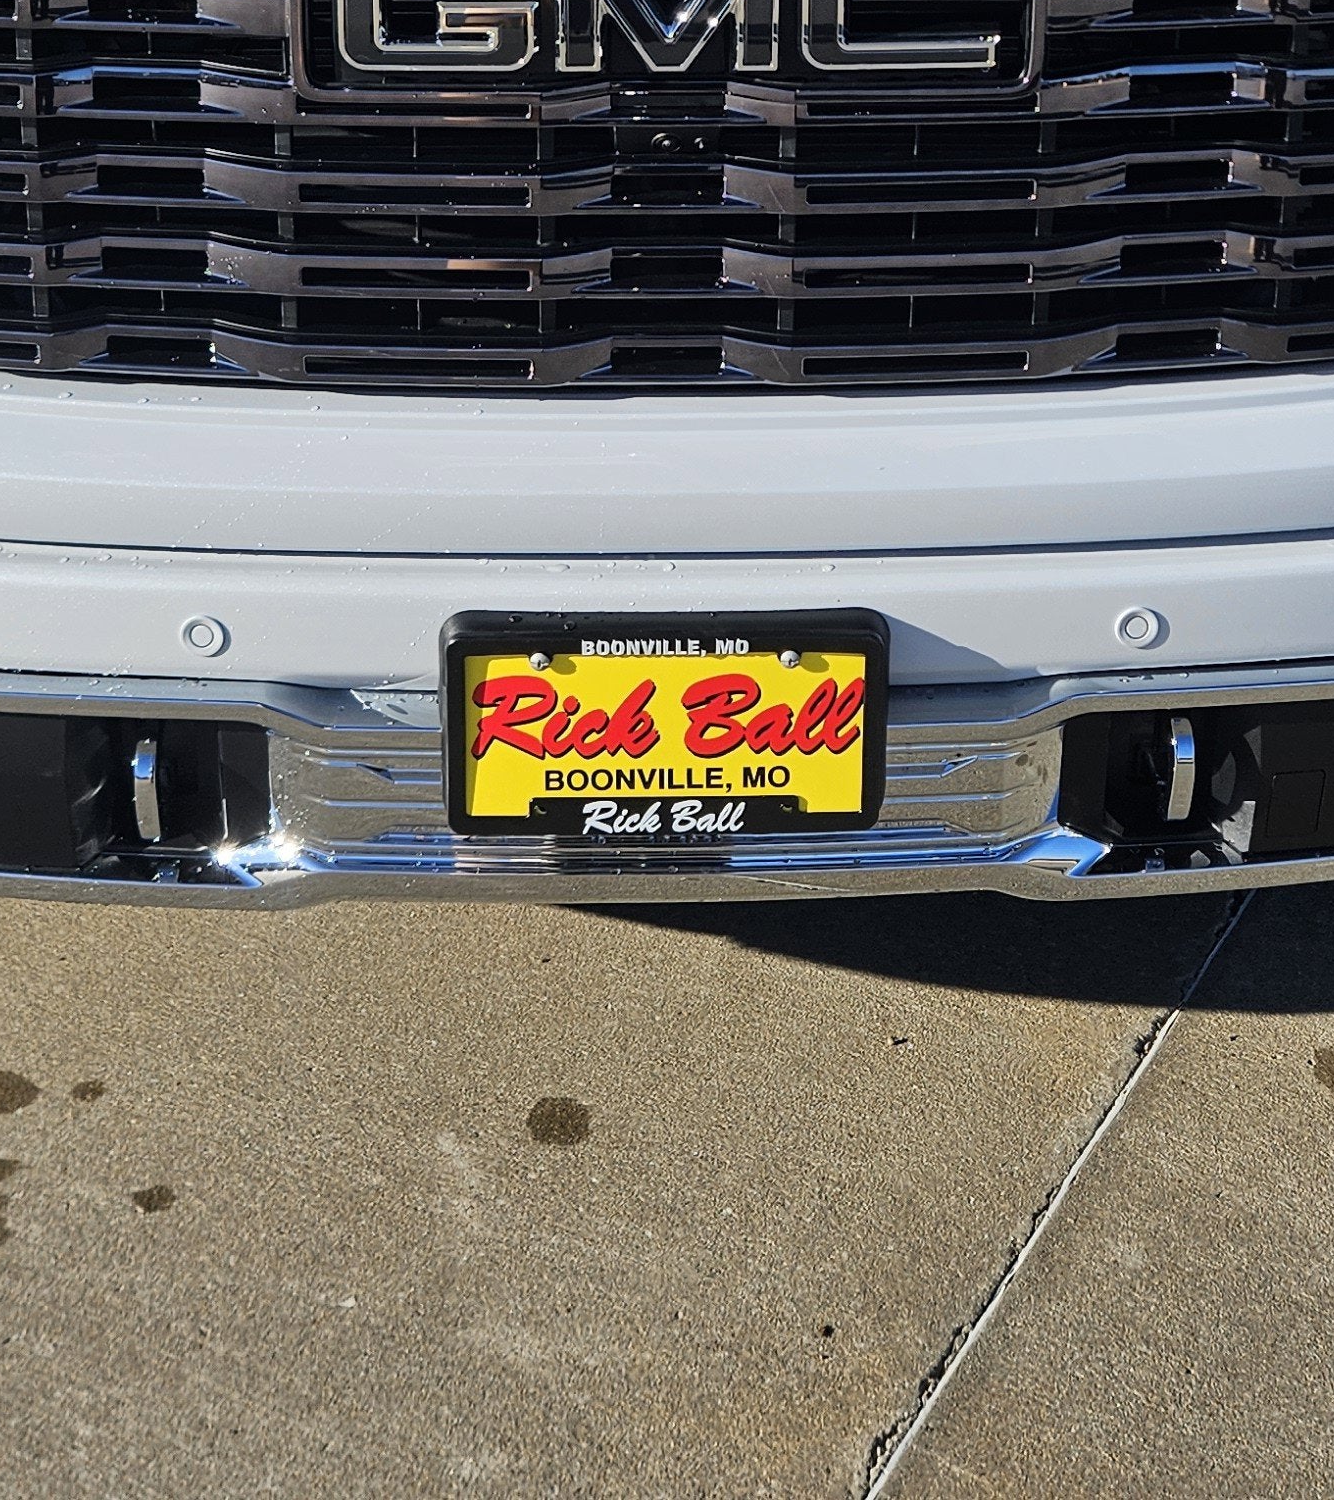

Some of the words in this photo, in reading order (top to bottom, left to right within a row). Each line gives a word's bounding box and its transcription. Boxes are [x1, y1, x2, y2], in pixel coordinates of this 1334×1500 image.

[581, 639, 707, 657] BOONVILLE,
[715, 638, 750, 655] MO
[471, 675, 661, 760] Rick
[681, 673, 865, 760] Ball
[544, 767, 732, 793] BOONVILLE,
[742, 765, 791, 788] MO
[582, 800, 662, 835] Rick
[671, 801, 745, 832] Ball
